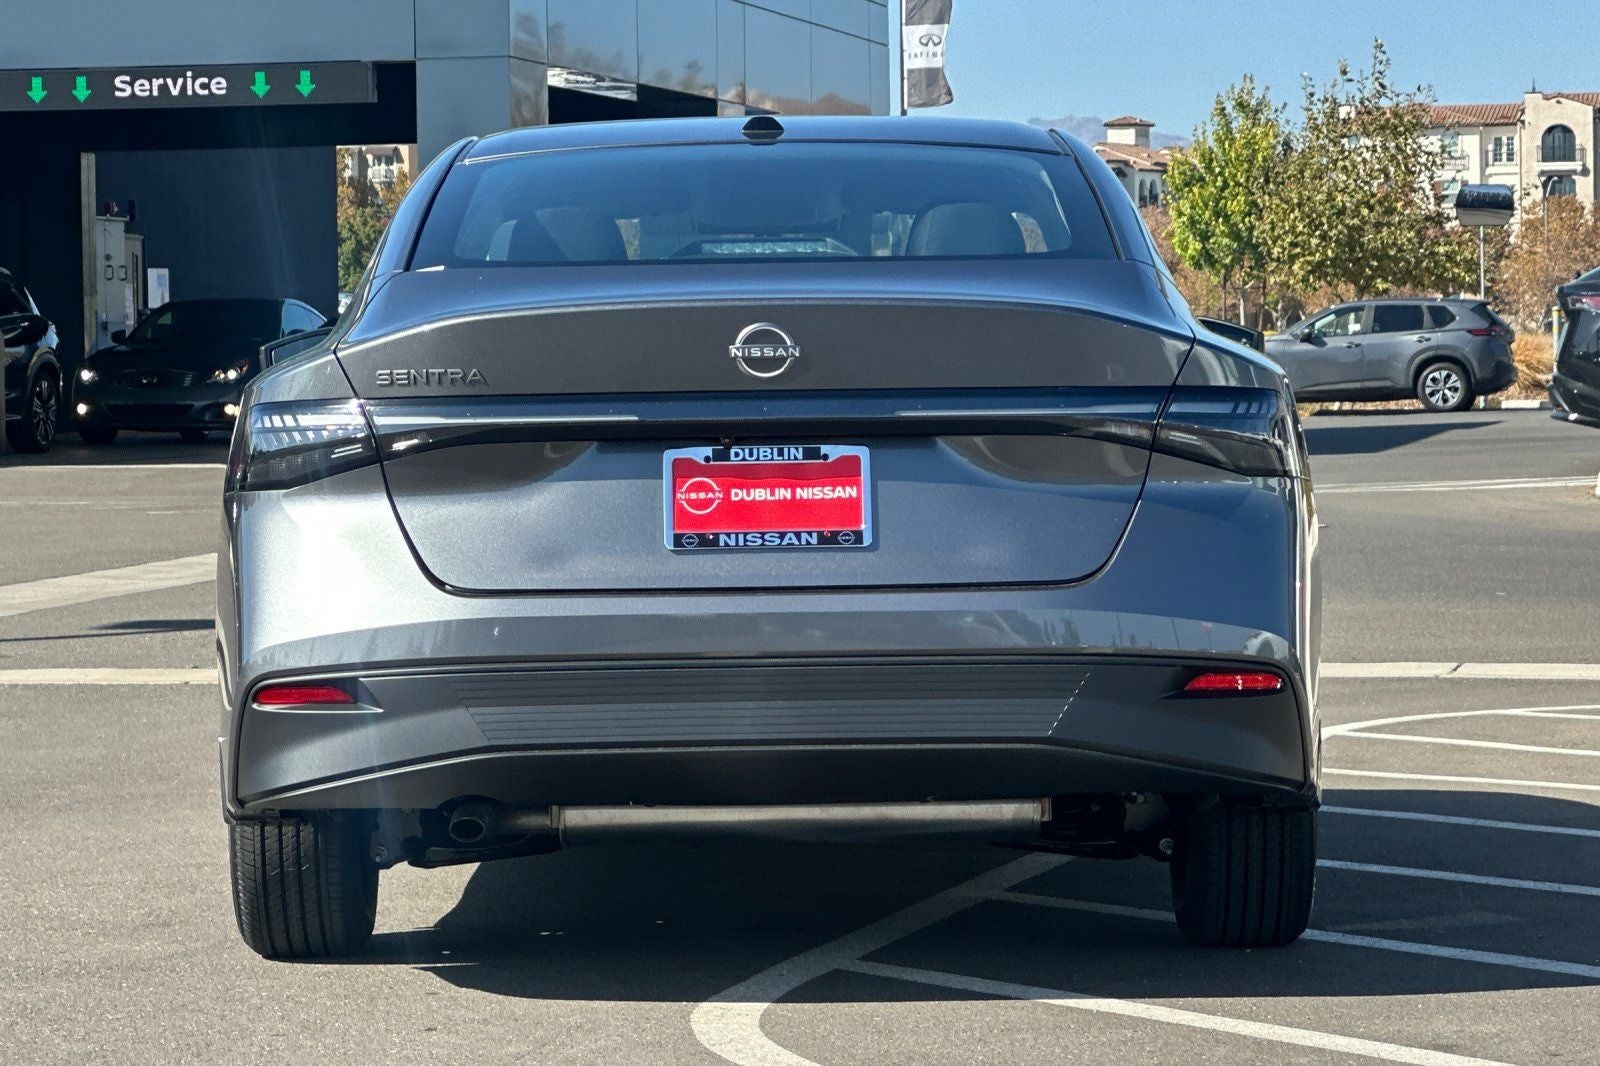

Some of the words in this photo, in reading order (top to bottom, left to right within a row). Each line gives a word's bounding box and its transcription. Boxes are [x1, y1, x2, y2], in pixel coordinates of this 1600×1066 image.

[114, 70, 227, 97] Service
[731, 347, 800, 357] NISSAN
[376, 368, 485, 386] SENTRA
[730, 447, 803, 461] DUBLIN
[677, 491, 724, 499] NISSAN
[731, 488, 791, 501] DUBLIN
[796, 486, 857, 500] NISSAN
[719, 532, 818, 546] NISSAN
